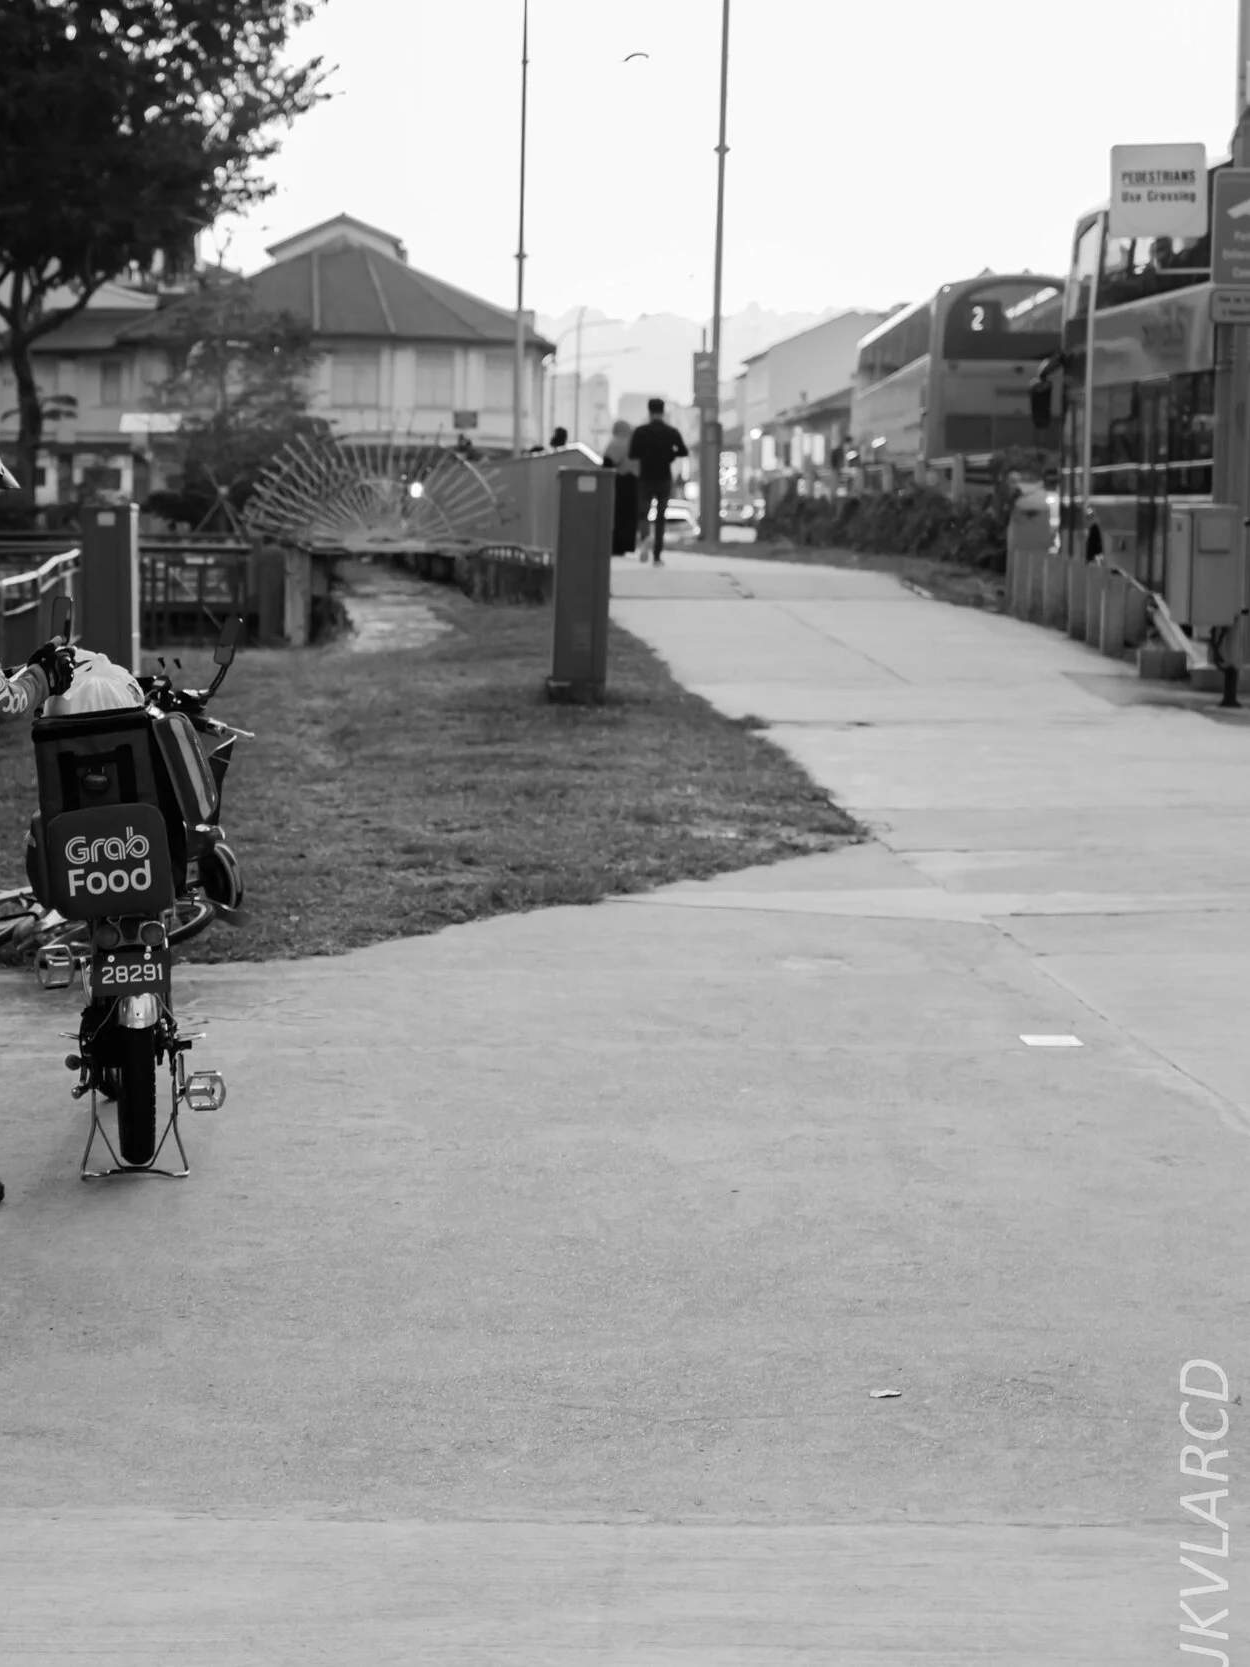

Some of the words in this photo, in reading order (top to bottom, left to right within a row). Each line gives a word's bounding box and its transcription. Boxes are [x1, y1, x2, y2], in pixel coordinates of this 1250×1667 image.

[1121, 170, 1196, 184] PEDESTRIANS
[971, 305, 984, 331] 2
[65, 826, 149, 864] Grab
[67, 859, 151, 897] Food
[101, 963, 163, 984] 28291
